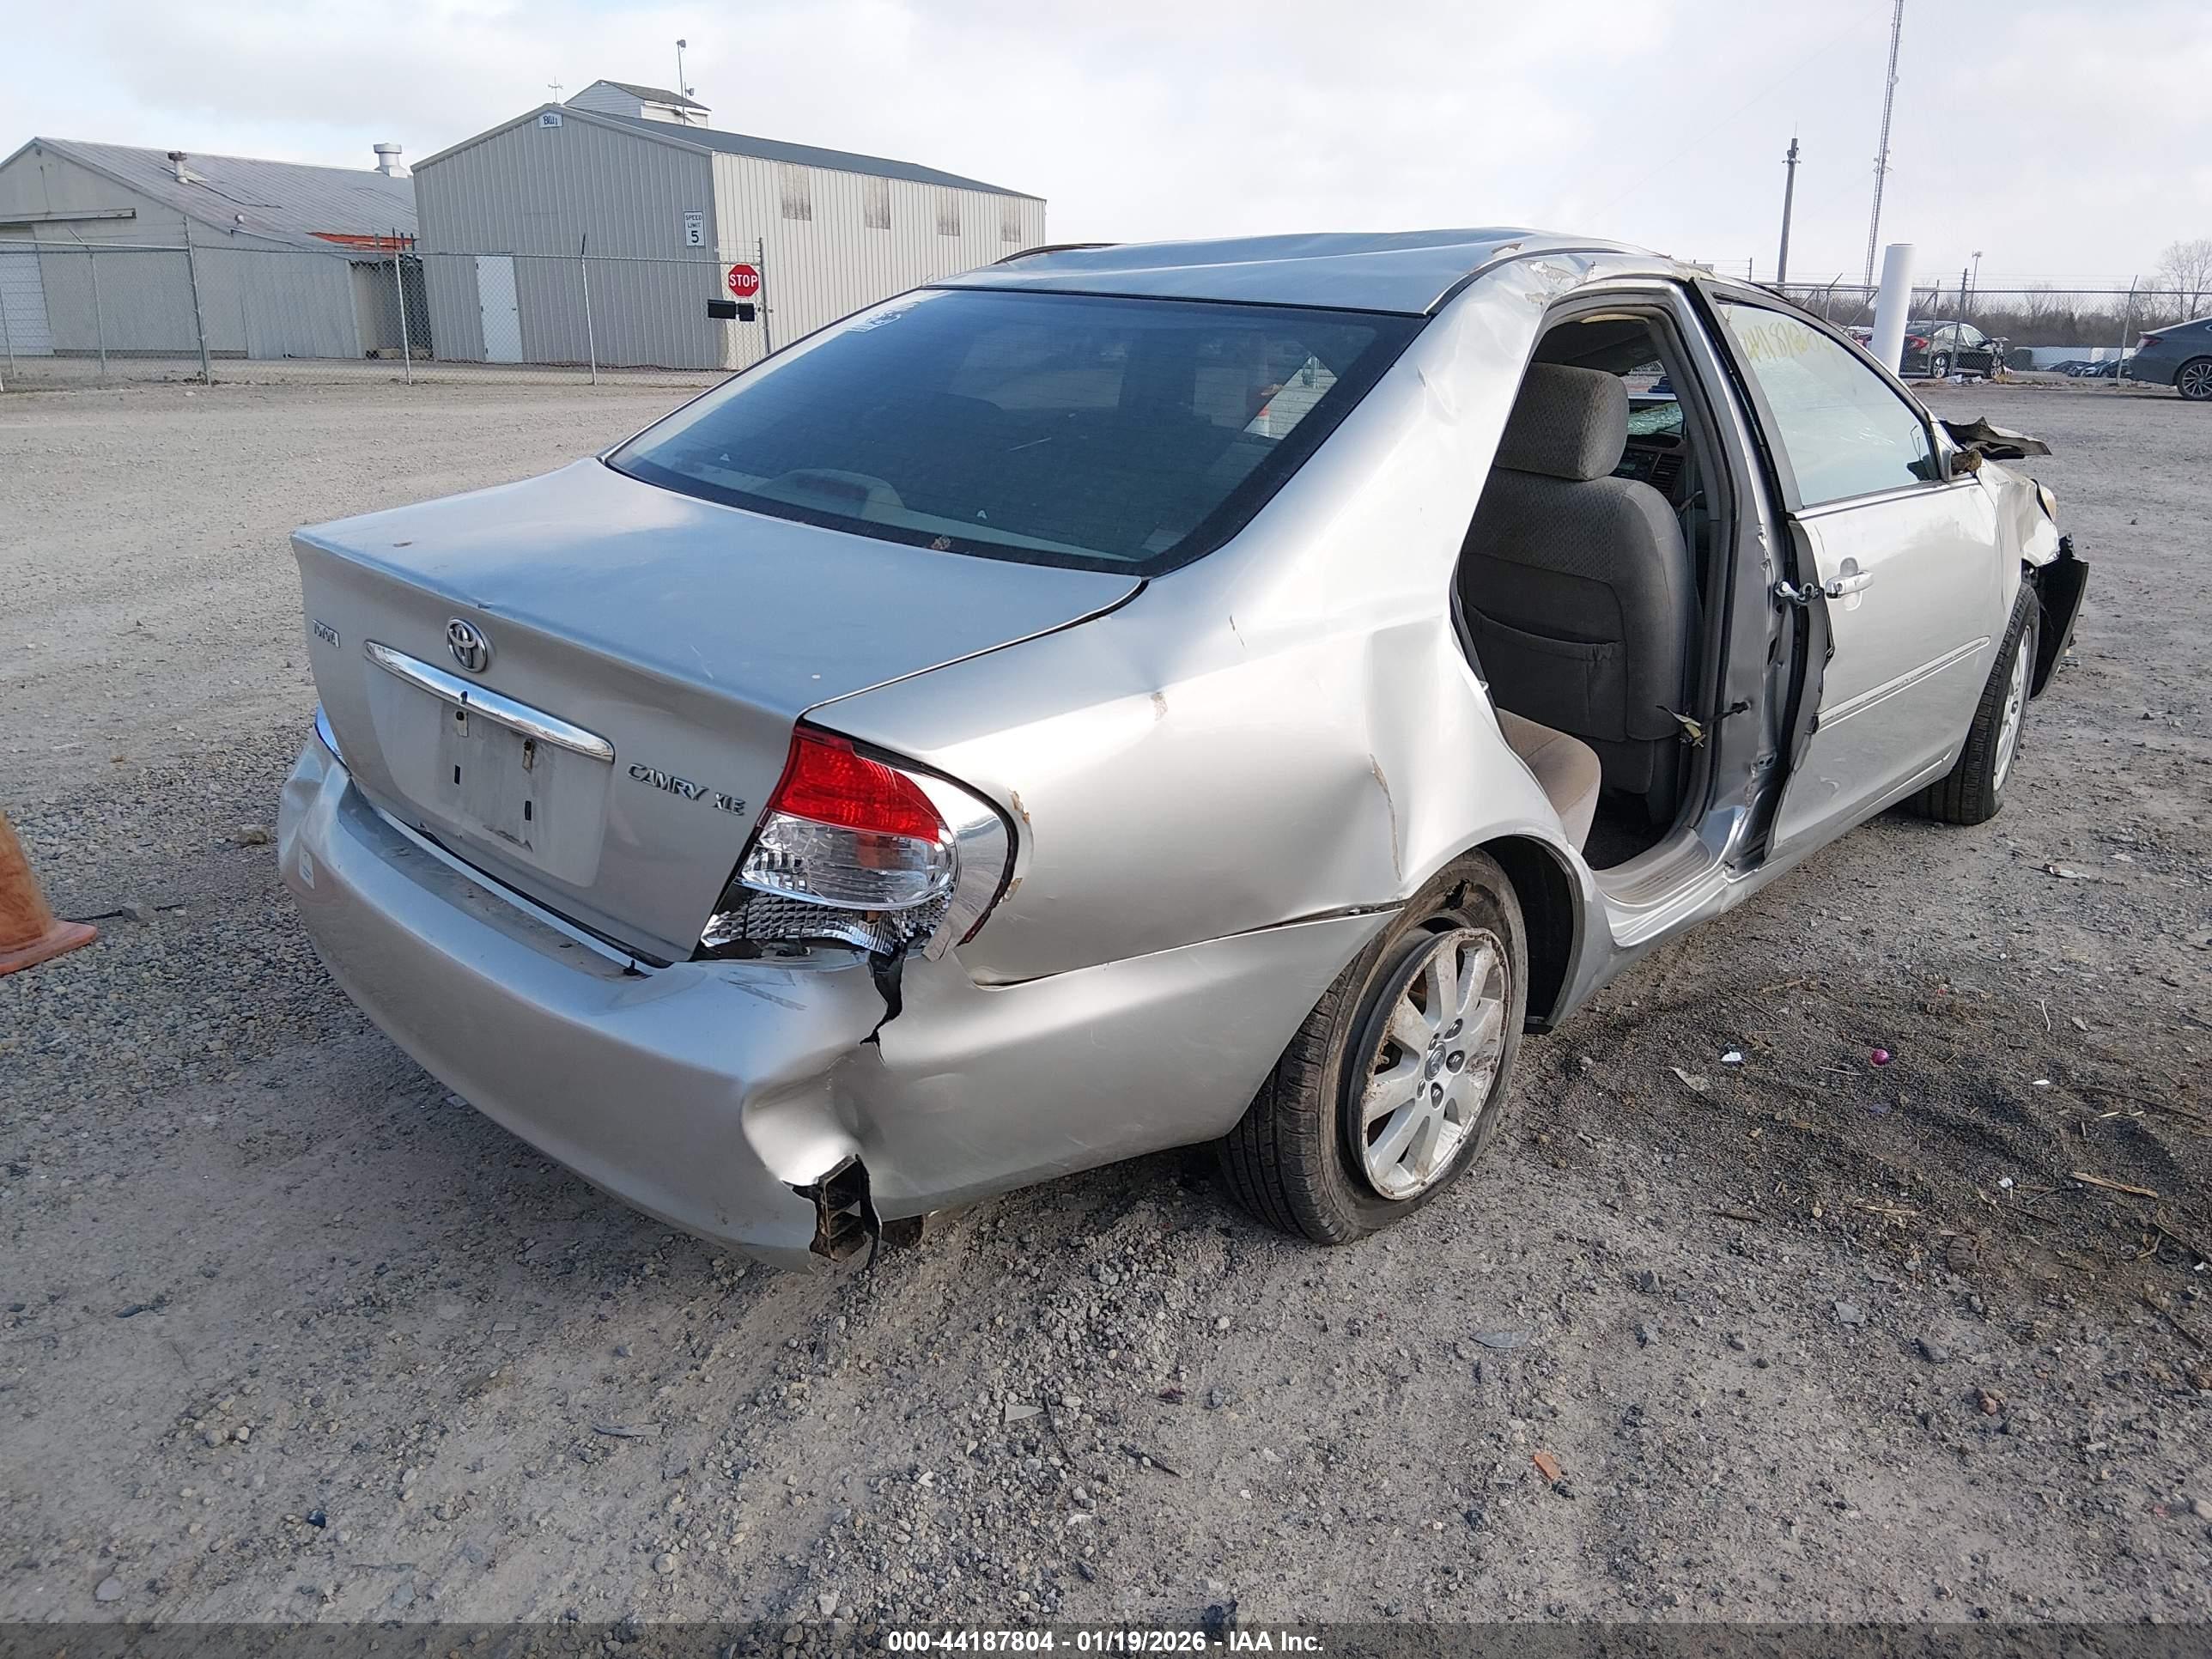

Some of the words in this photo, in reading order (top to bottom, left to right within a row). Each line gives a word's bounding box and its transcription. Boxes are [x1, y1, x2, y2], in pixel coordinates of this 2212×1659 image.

[690, 230, 700, 243] 5
[729, 274, 758, 288] STOP
[626, 763, 709, 801] CAMRY
[713, 792, 747, 817] XLE
